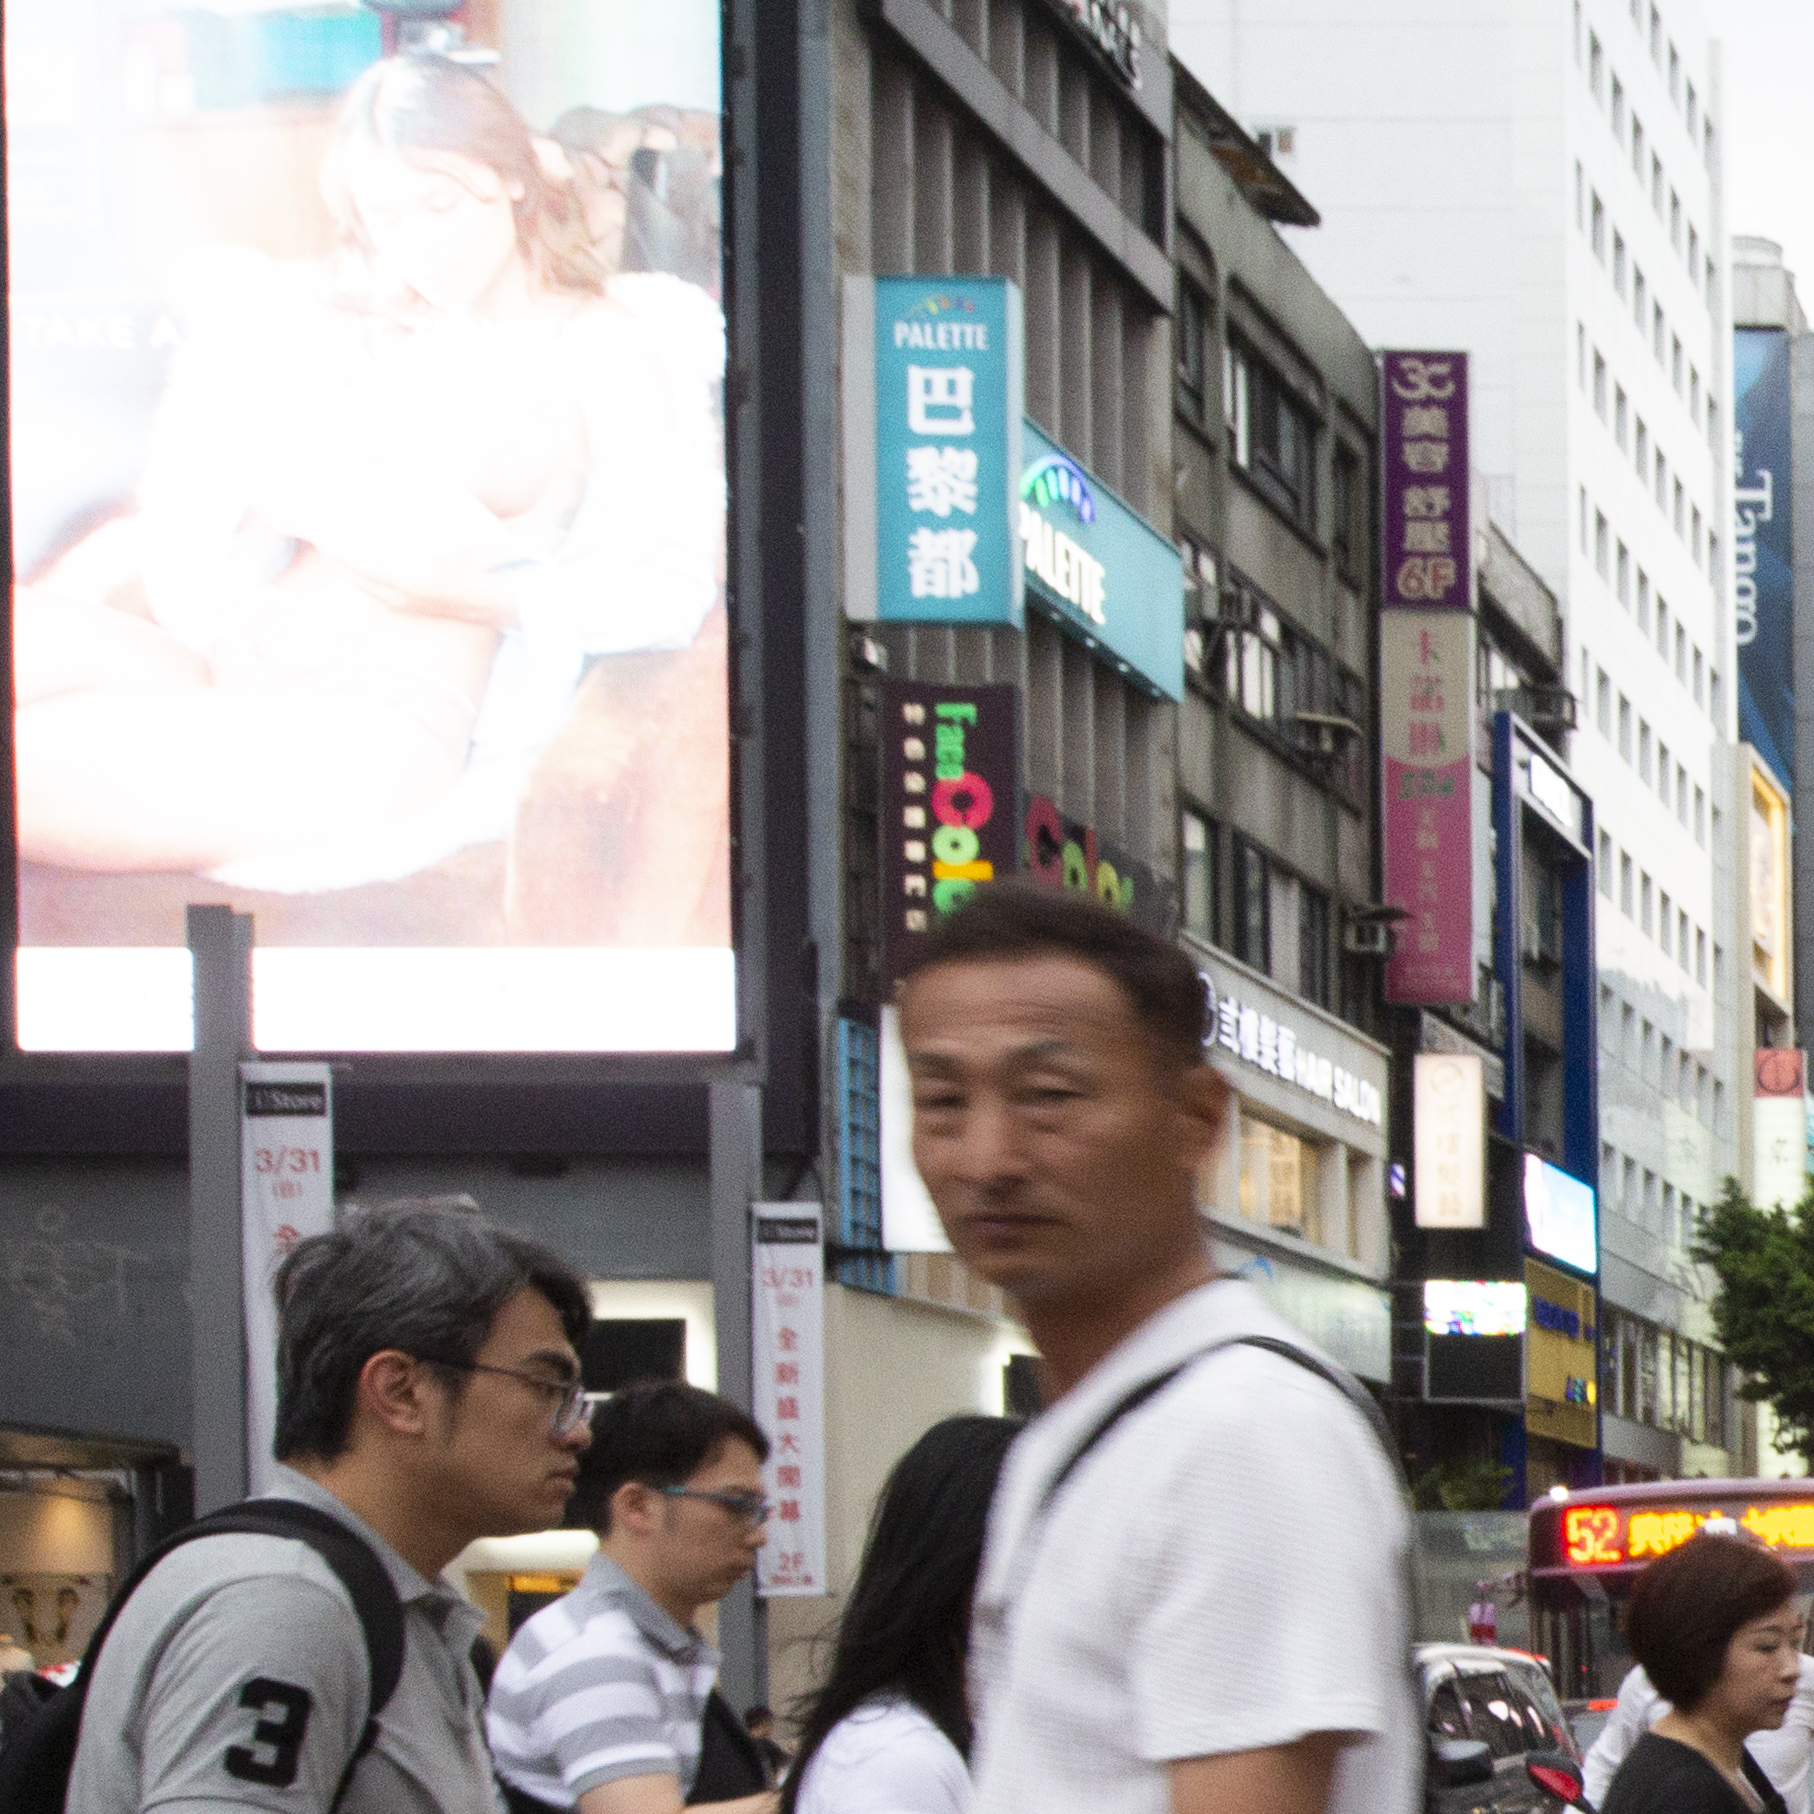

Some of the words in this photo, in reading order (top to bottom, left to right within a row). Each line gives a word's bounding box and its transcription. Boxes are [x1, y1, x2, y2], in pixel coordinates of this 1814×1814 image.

[20, 313, 135, 349] TAKE
[893, 321, 989, 351] PALETTE
[906, 363, 980, 599] 巴黎都
[1396, 557, 1457, 599] 6F
[255, 1147, 321, 1174] 3/31
[761, 1266, 814, 1288] 3/31
[1564, 1506, 1622, 1563] 52
[778, 1552, 803, 1572] 2F
[223, 1677, 313, 1788] 3
